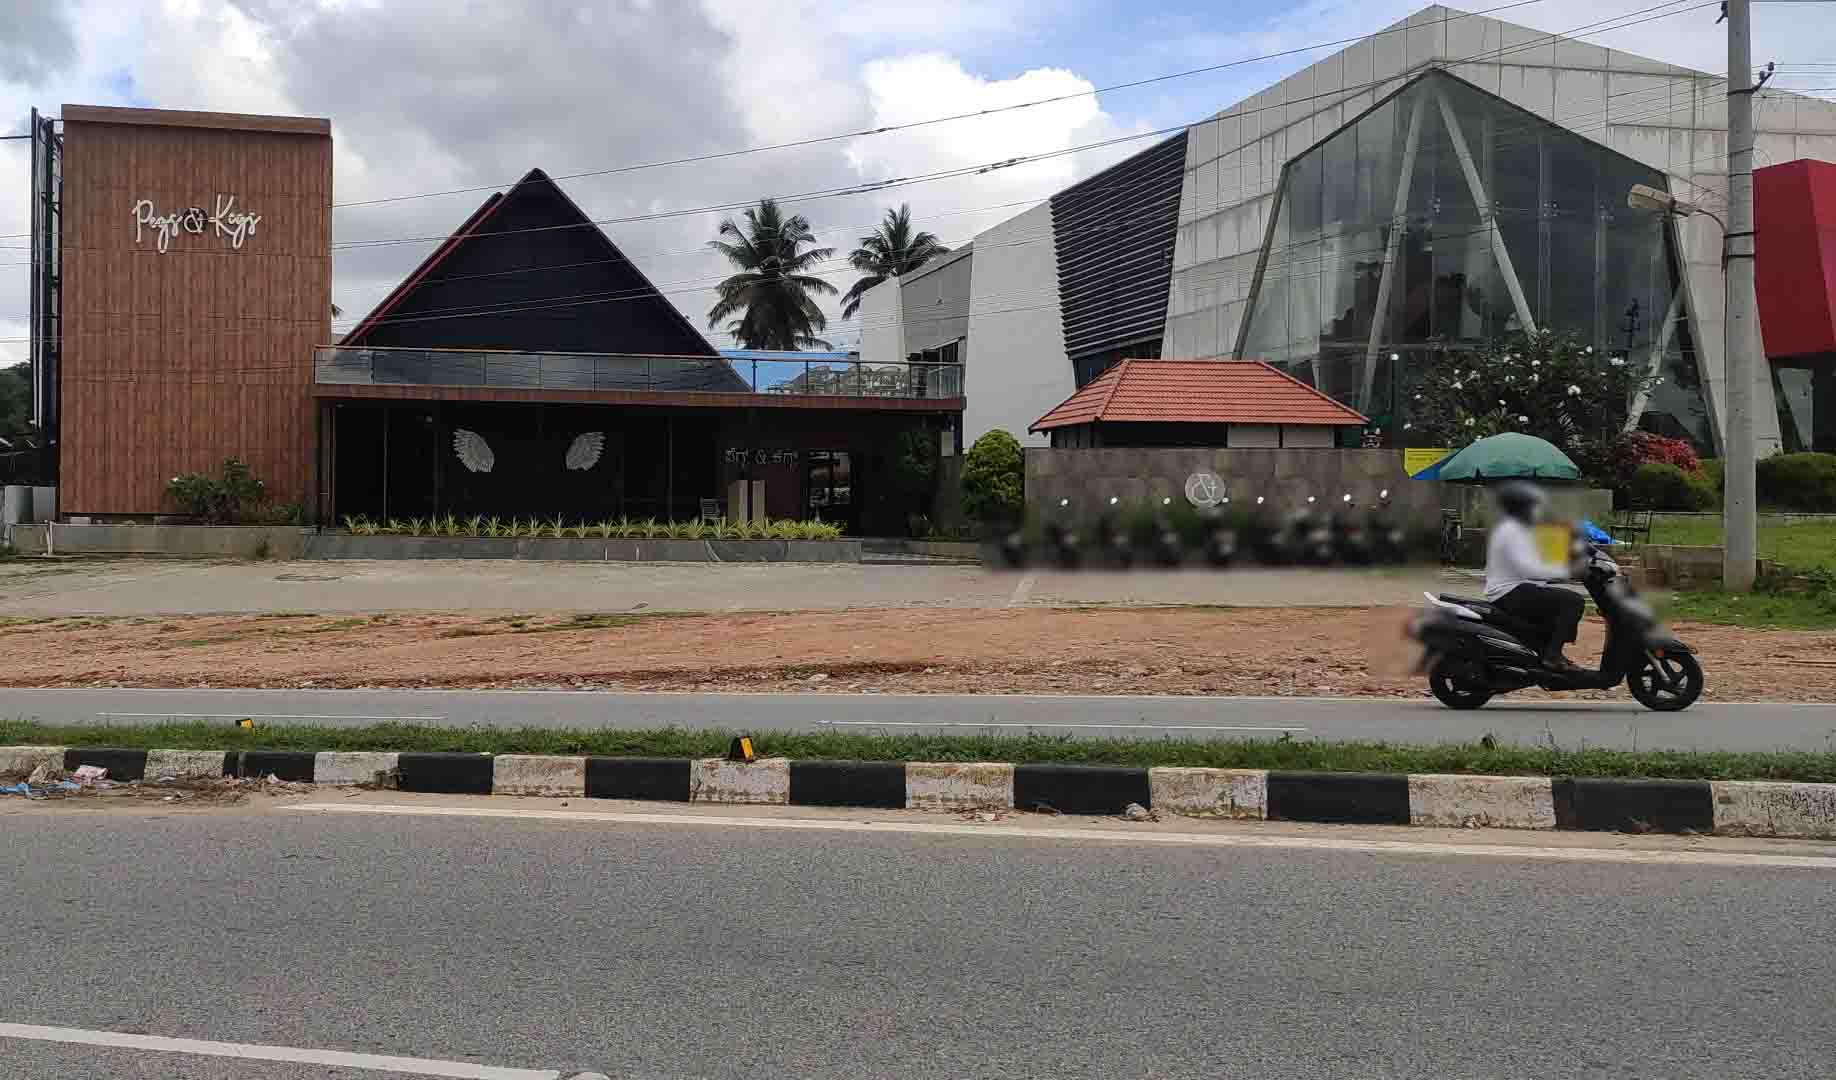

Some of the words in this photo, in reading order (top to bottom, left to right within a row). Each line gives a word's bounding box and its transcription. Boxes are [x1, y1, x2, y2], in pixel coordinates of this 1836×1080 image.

[131, 199, 183, 253] Pegs
[183, 207, 206, 233] &
[207, 193, 262, 249] Kegs
